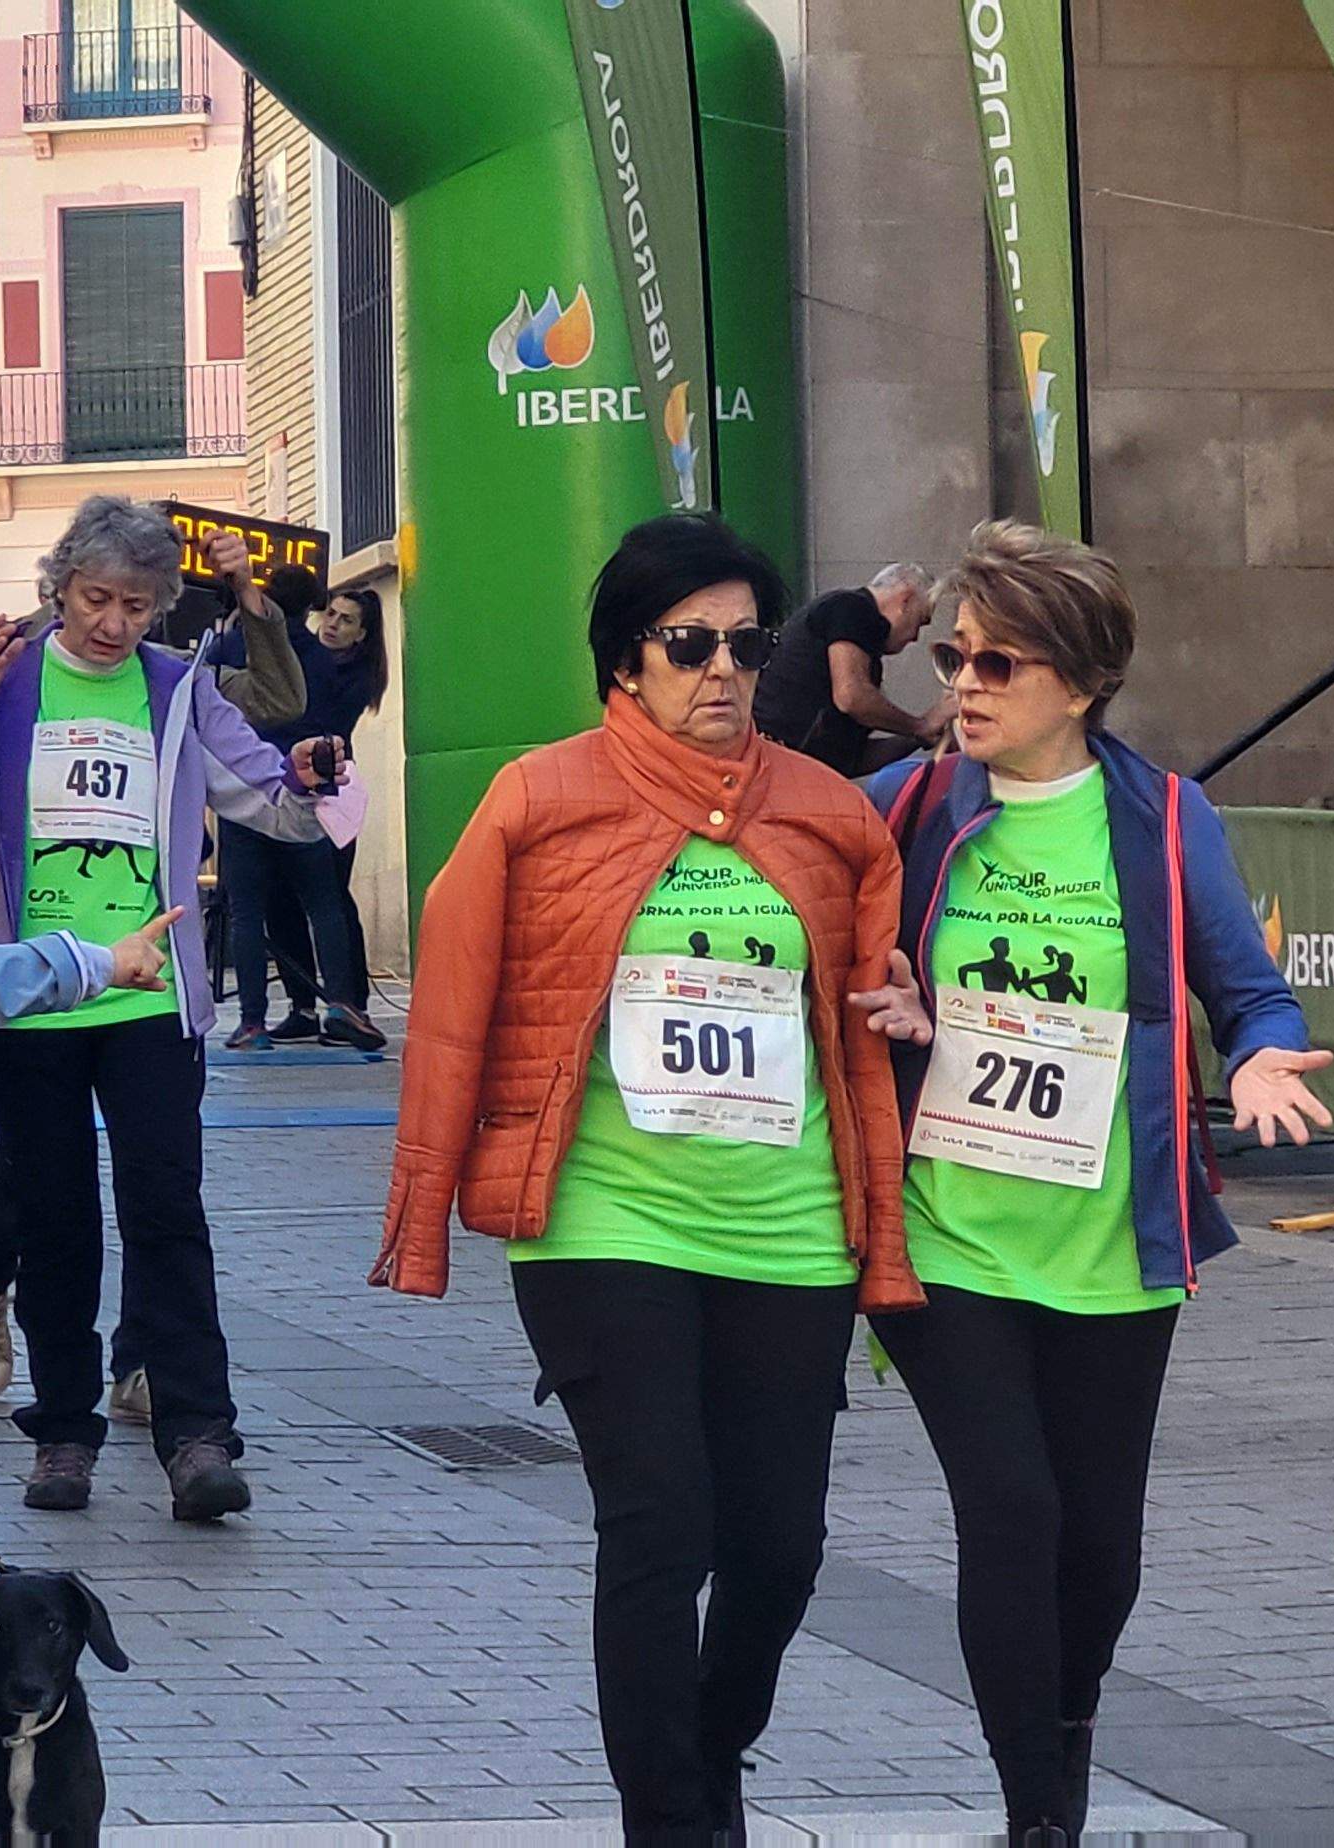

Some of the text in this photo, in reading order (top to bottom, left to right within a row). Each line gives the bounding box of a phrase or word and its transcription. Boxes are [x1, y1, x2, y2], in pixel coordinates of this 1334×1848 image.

[517, 386, 754, 427] IBERDLA
[66, 759, 129, 800] 437
[671, 875, 768, 892] UNIVERSO MU
[1054, 881, 1101, 897] MUJER
[688, 906, 724, 916] POR
[729, 905, 750, 916] LA
[996, 912, 1029, 924] POR
[1032, 912, 1052, 924] LA
[662, 1018, 756, 1079] 501
[968, 1051, 1065, 1120] 276
